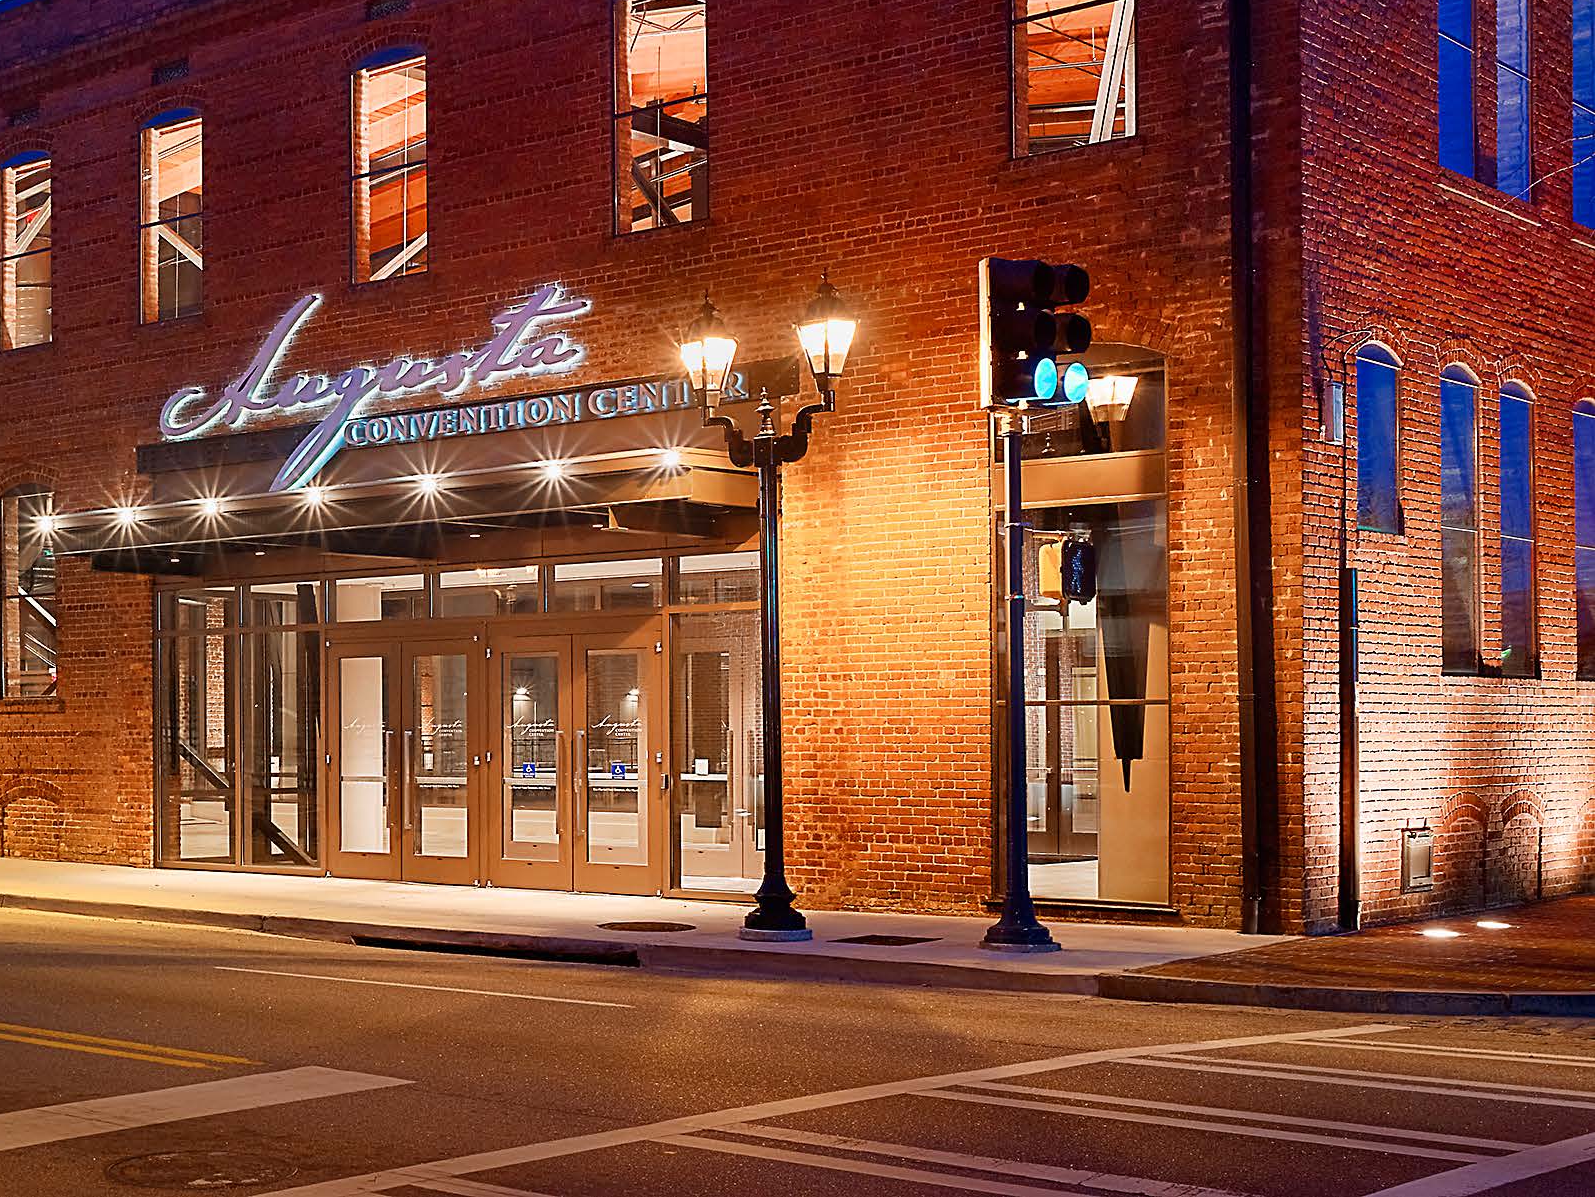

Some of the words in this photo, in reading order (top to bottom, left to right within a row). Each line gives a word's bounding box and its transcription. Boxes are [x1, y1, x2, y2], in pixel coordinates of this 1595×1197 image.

[160, 286, 593, 492] Augusta
[343, 393, 579, 446] CONVENTION
[589, 371, 750, 417] CENTR
